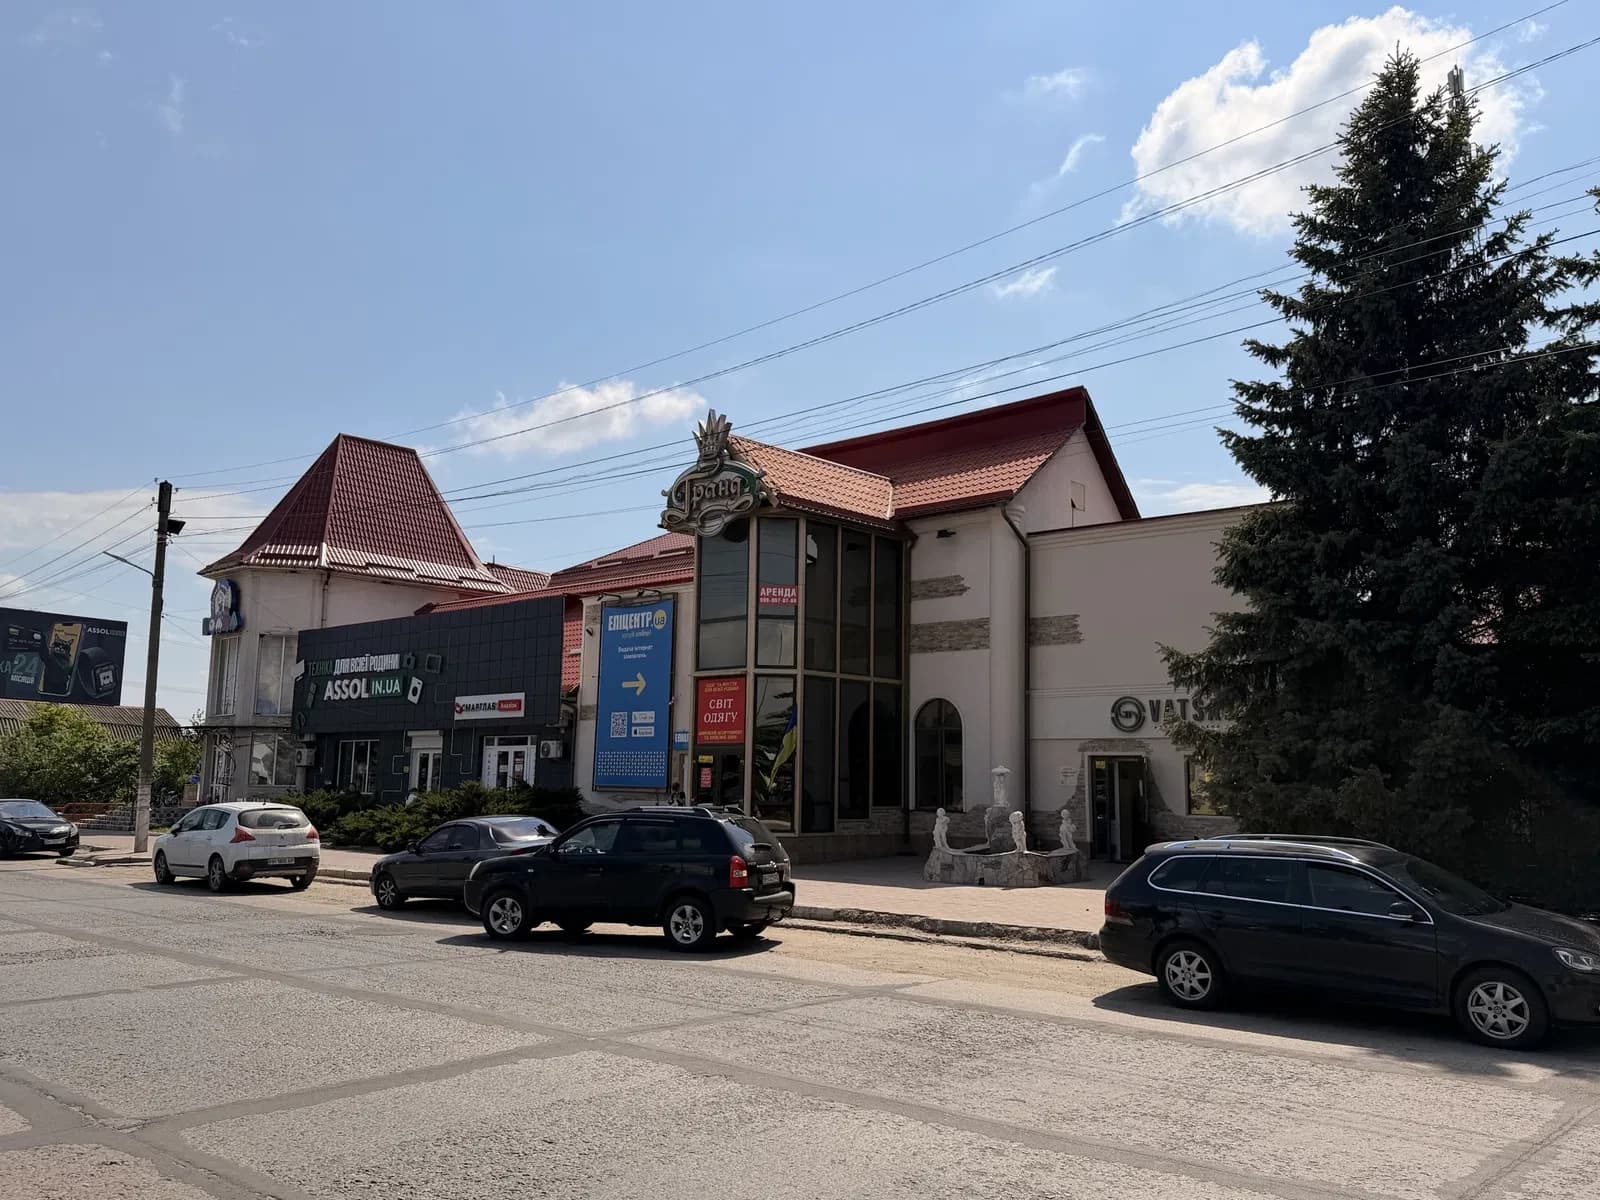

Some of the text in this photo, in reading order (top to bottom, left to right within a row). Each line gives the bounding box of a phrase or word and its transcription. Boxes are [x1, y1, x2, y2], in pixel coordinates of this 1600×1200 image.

[760, 587, 796, 598] АРЕНДА
[87, 627, 110, 636] ASSOL
[13, 654, 39, 673] 24
[334, 659, 350, 676] ДЛЯ
[370, 654, 400, 672] РОДИНИ
[324, 678, 400, 701] ASSOL IN.UA
[709, 698, 734, 710] СВІТ
[704, 712, 738, 723] ОДЯГУ
